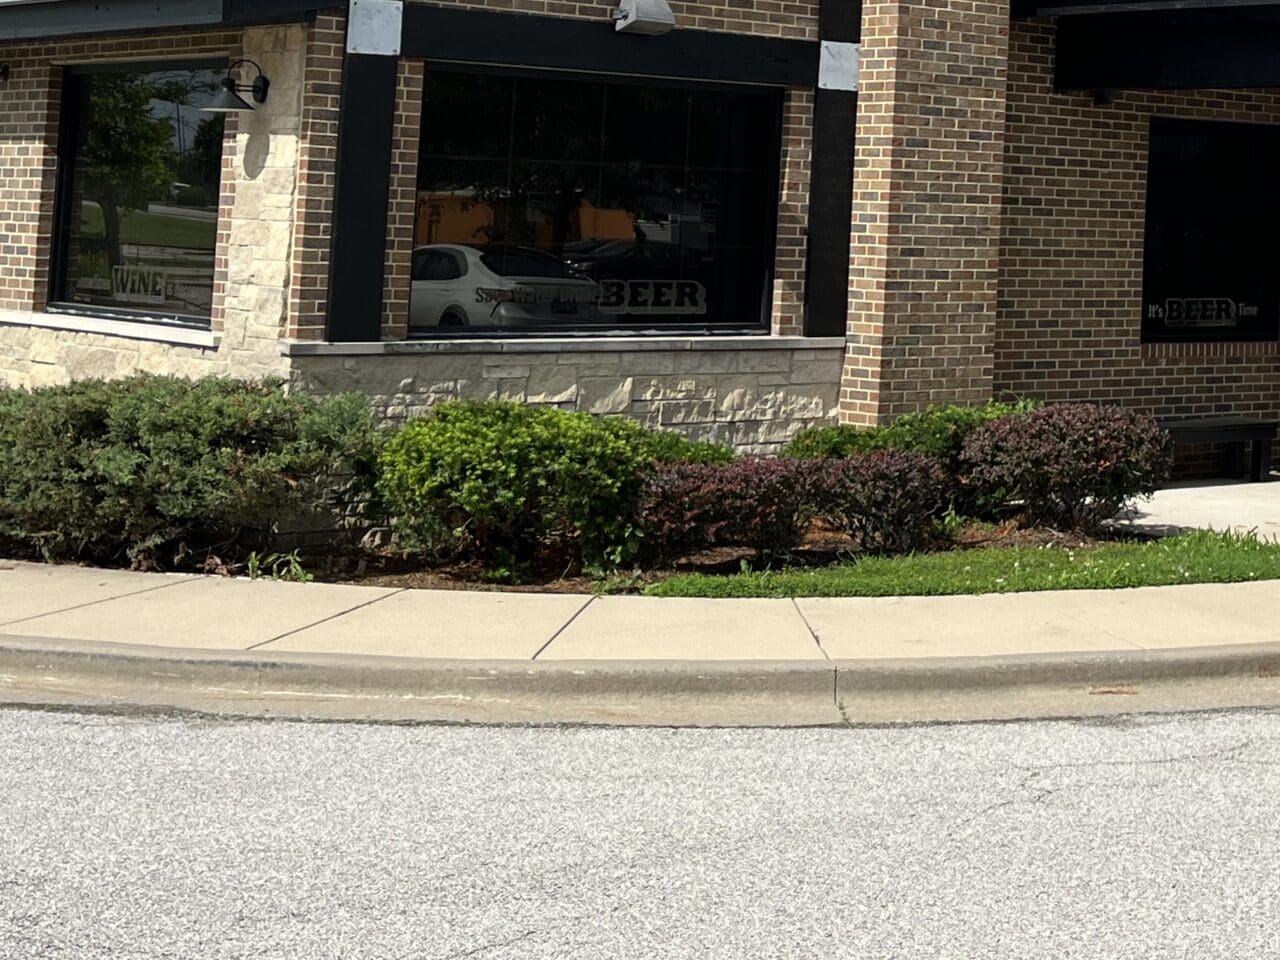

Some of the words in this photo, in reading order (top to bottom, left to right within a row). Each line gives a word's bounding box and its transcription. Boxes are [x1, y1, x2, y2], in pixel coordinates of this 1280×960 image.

[600, 280, 705, 312] BEER
[1148, 303, 1164, 319] It's
[1166, 298, 1236, 326] BEER
[1238, 302, 1259, 317] Time
